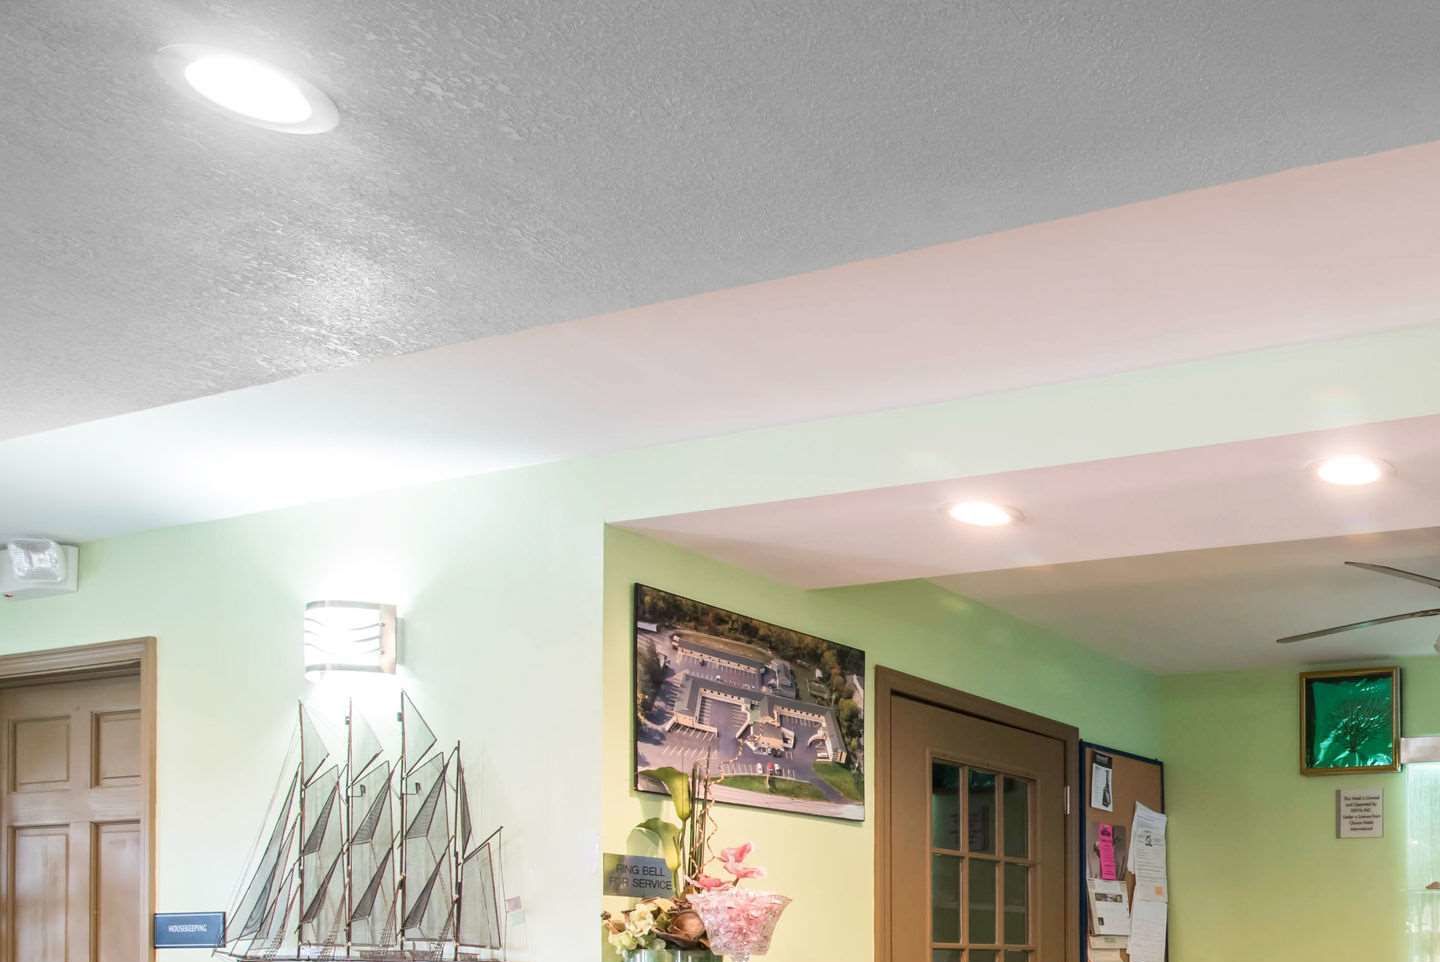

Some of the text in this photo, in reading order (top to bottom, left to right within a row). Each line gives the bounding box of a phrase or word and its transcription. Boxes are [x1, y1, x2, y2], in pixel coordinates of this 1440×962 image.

[616, 864, 664, 876] RING BELL
[609, 876, 672, 890] FOR SERVICE
[168, 924, 207, 933] HOUSEKEEPING
